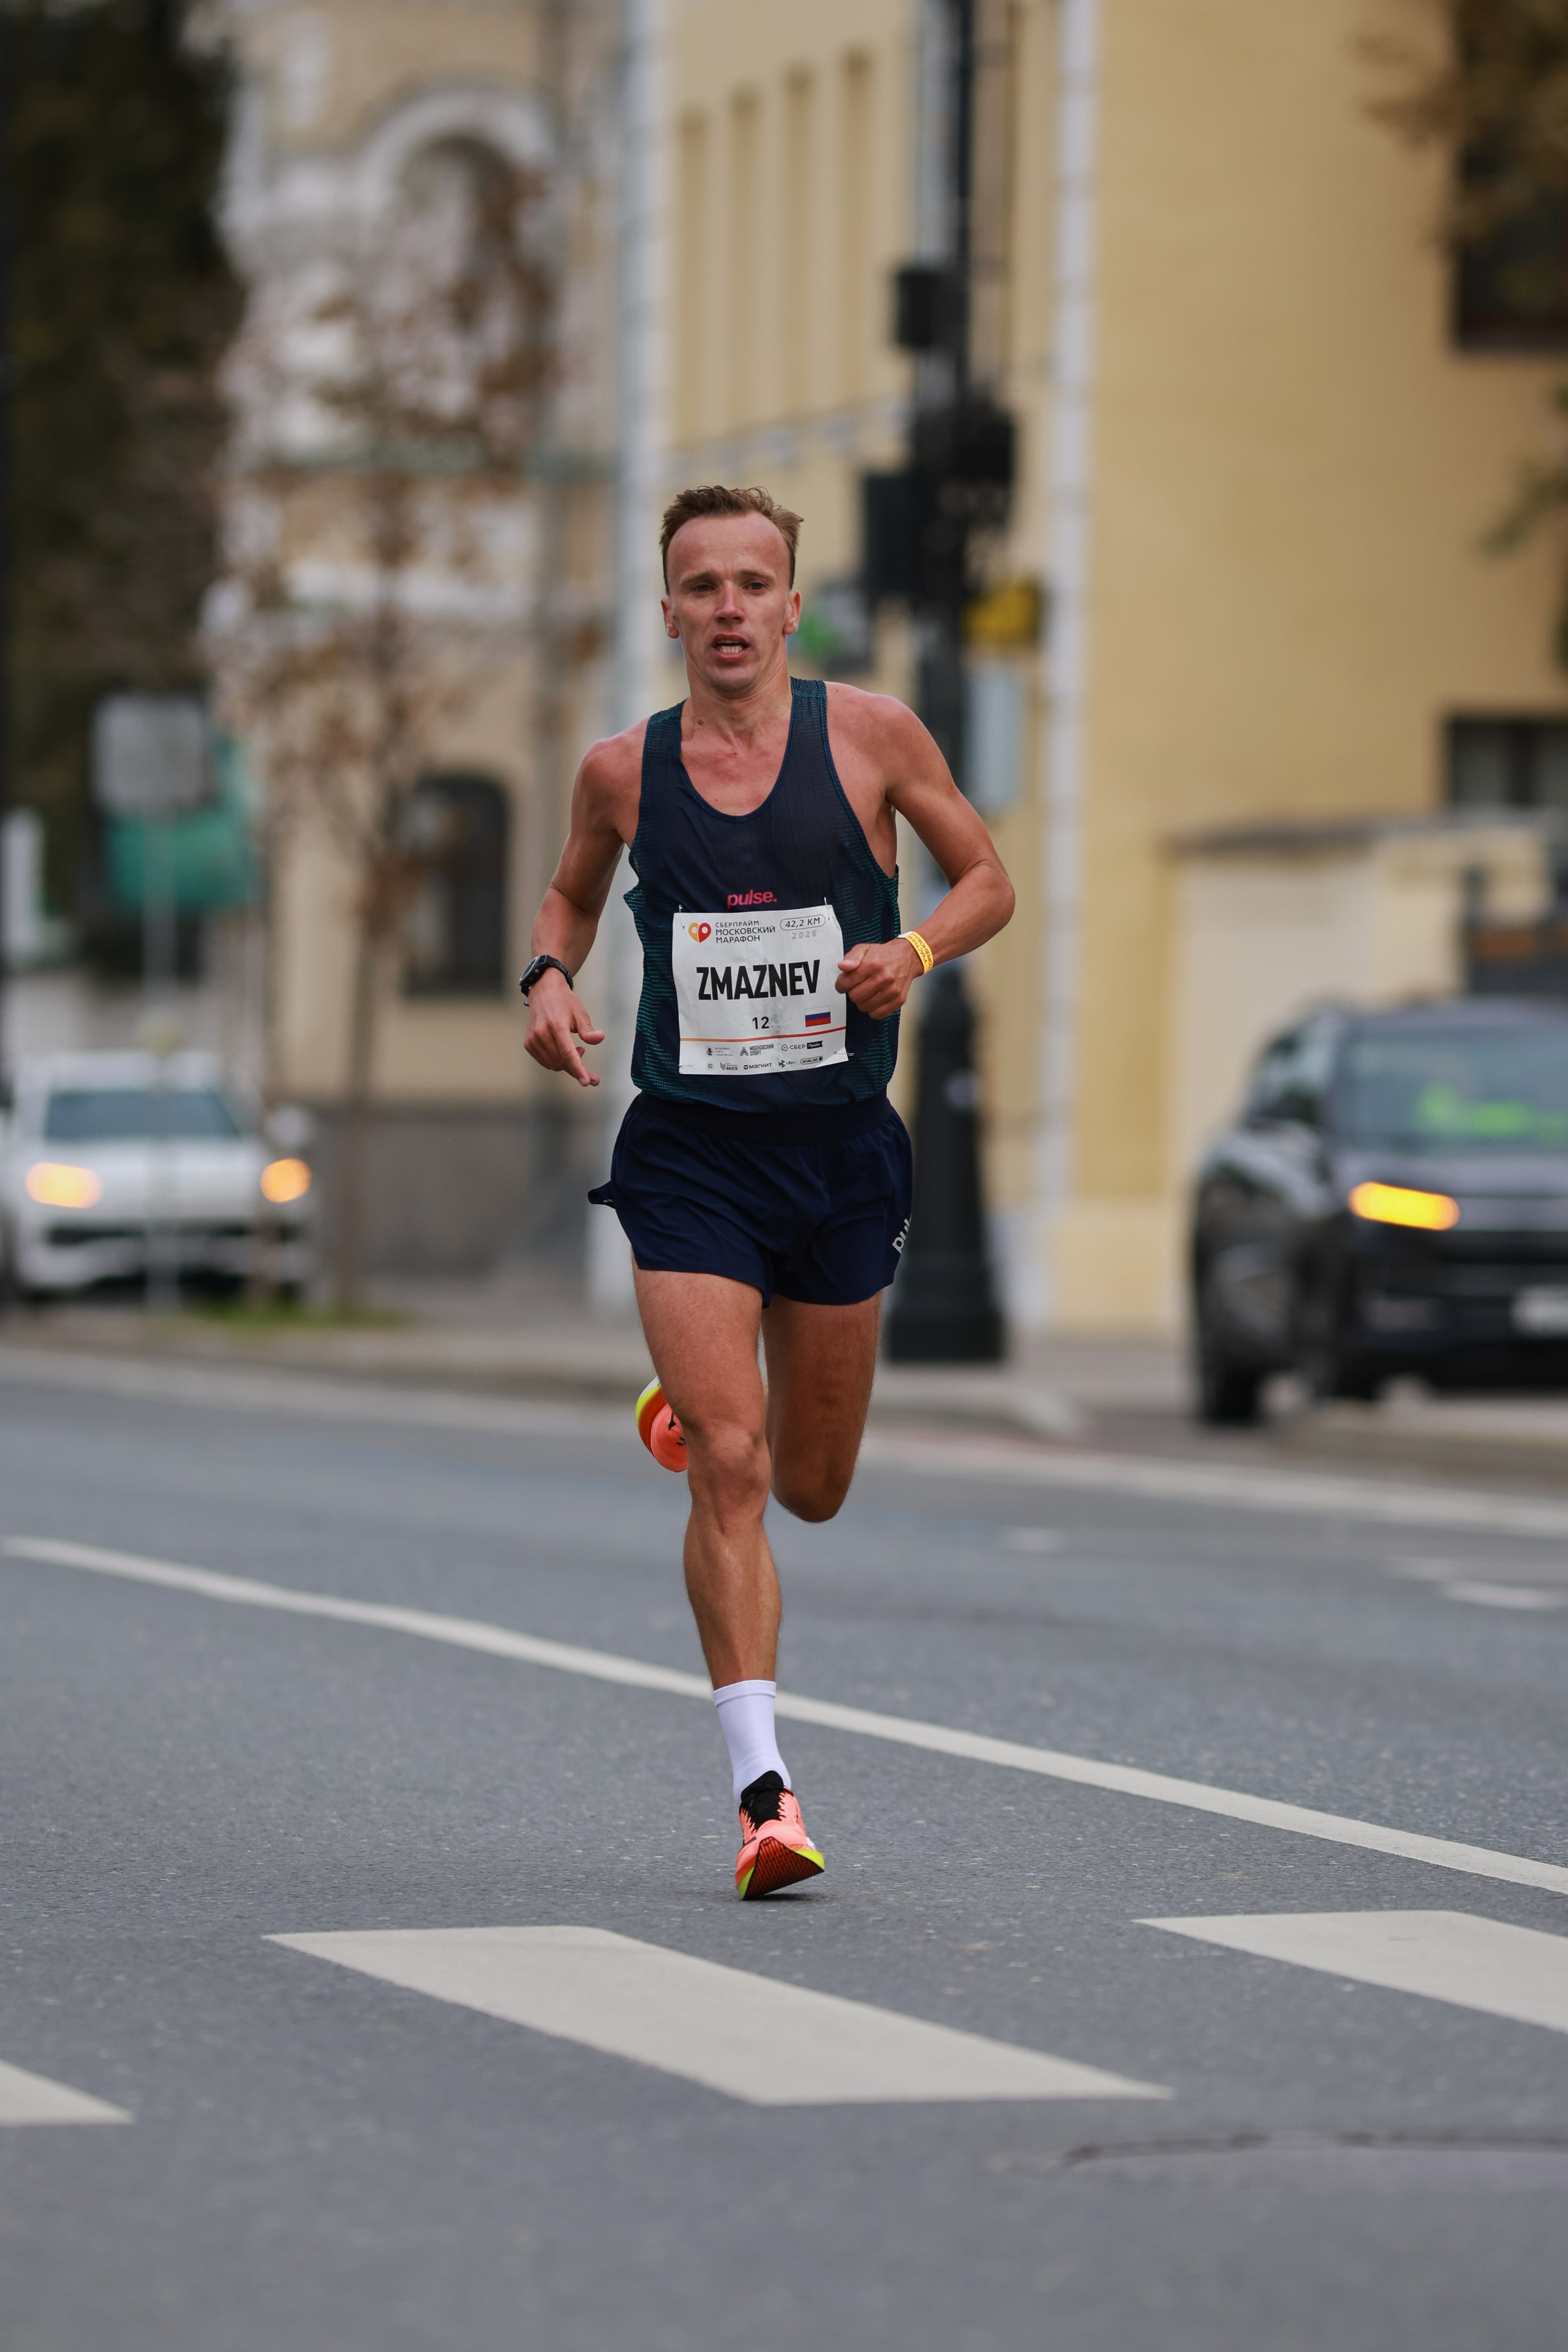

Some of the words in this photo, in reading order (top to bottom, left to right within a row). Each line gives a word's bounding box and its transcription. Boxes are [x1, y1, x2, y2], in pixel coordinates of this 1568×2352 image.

[727, 888, 777, 910] pulse.
[715, 925, 775, 935] МОСКОВСКИЙ
[785, 919, 804, 928] 42,2
[716, 935, 760, 943] МАРАФОН
[696, 959, 820, 1000] ZMAZNEV
[752, 1016, 769, 1030] 12
[892, 1214, 912, 1254] pul
